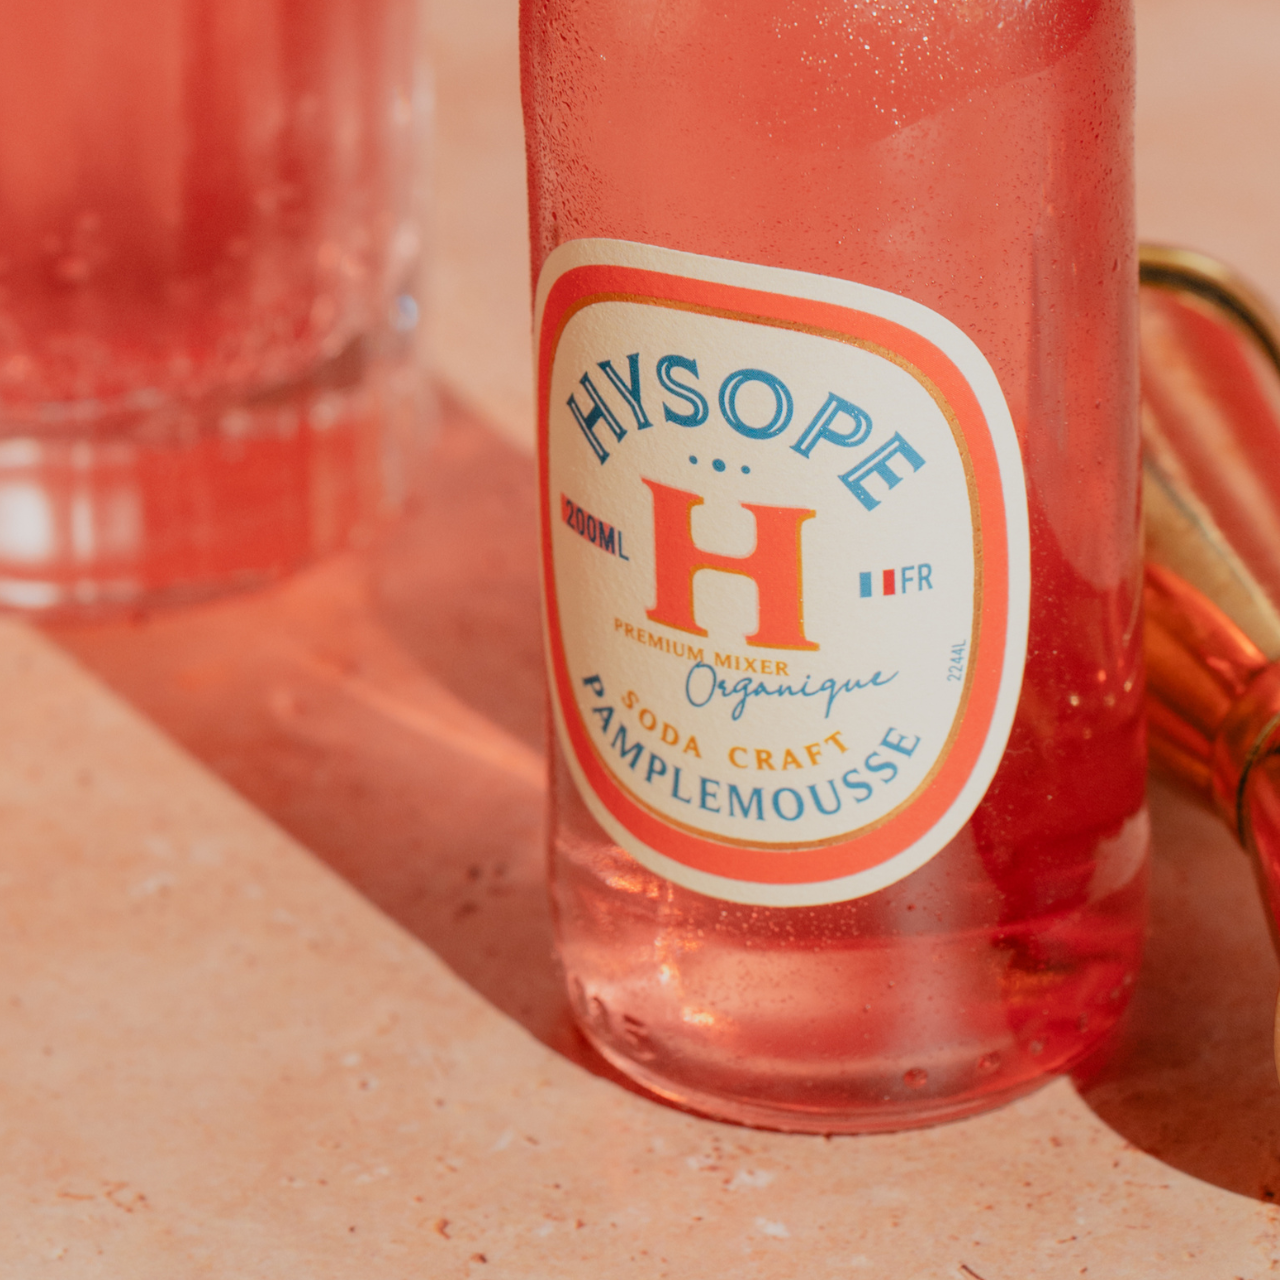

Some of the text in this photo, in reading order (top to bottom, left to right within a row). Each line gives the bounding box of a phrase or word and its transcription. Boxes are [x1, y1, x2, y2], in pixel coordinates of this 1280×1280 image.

[566, 351, 926, 512] HYSOPE
[565, 498, 630, 562] 200ML
[640, 475, 820, 652] H
[901, 562, 933, 594] FR
[613, 616, 790, 677] PREMIUM MIXER
[946, 639, 967, 682] 2244L
[685, 660, 899, 721] Organique
[581, 673, 922, 822] PAMPLEMOUSSE
[621, 689, 851, 772] SODA CRAFT
